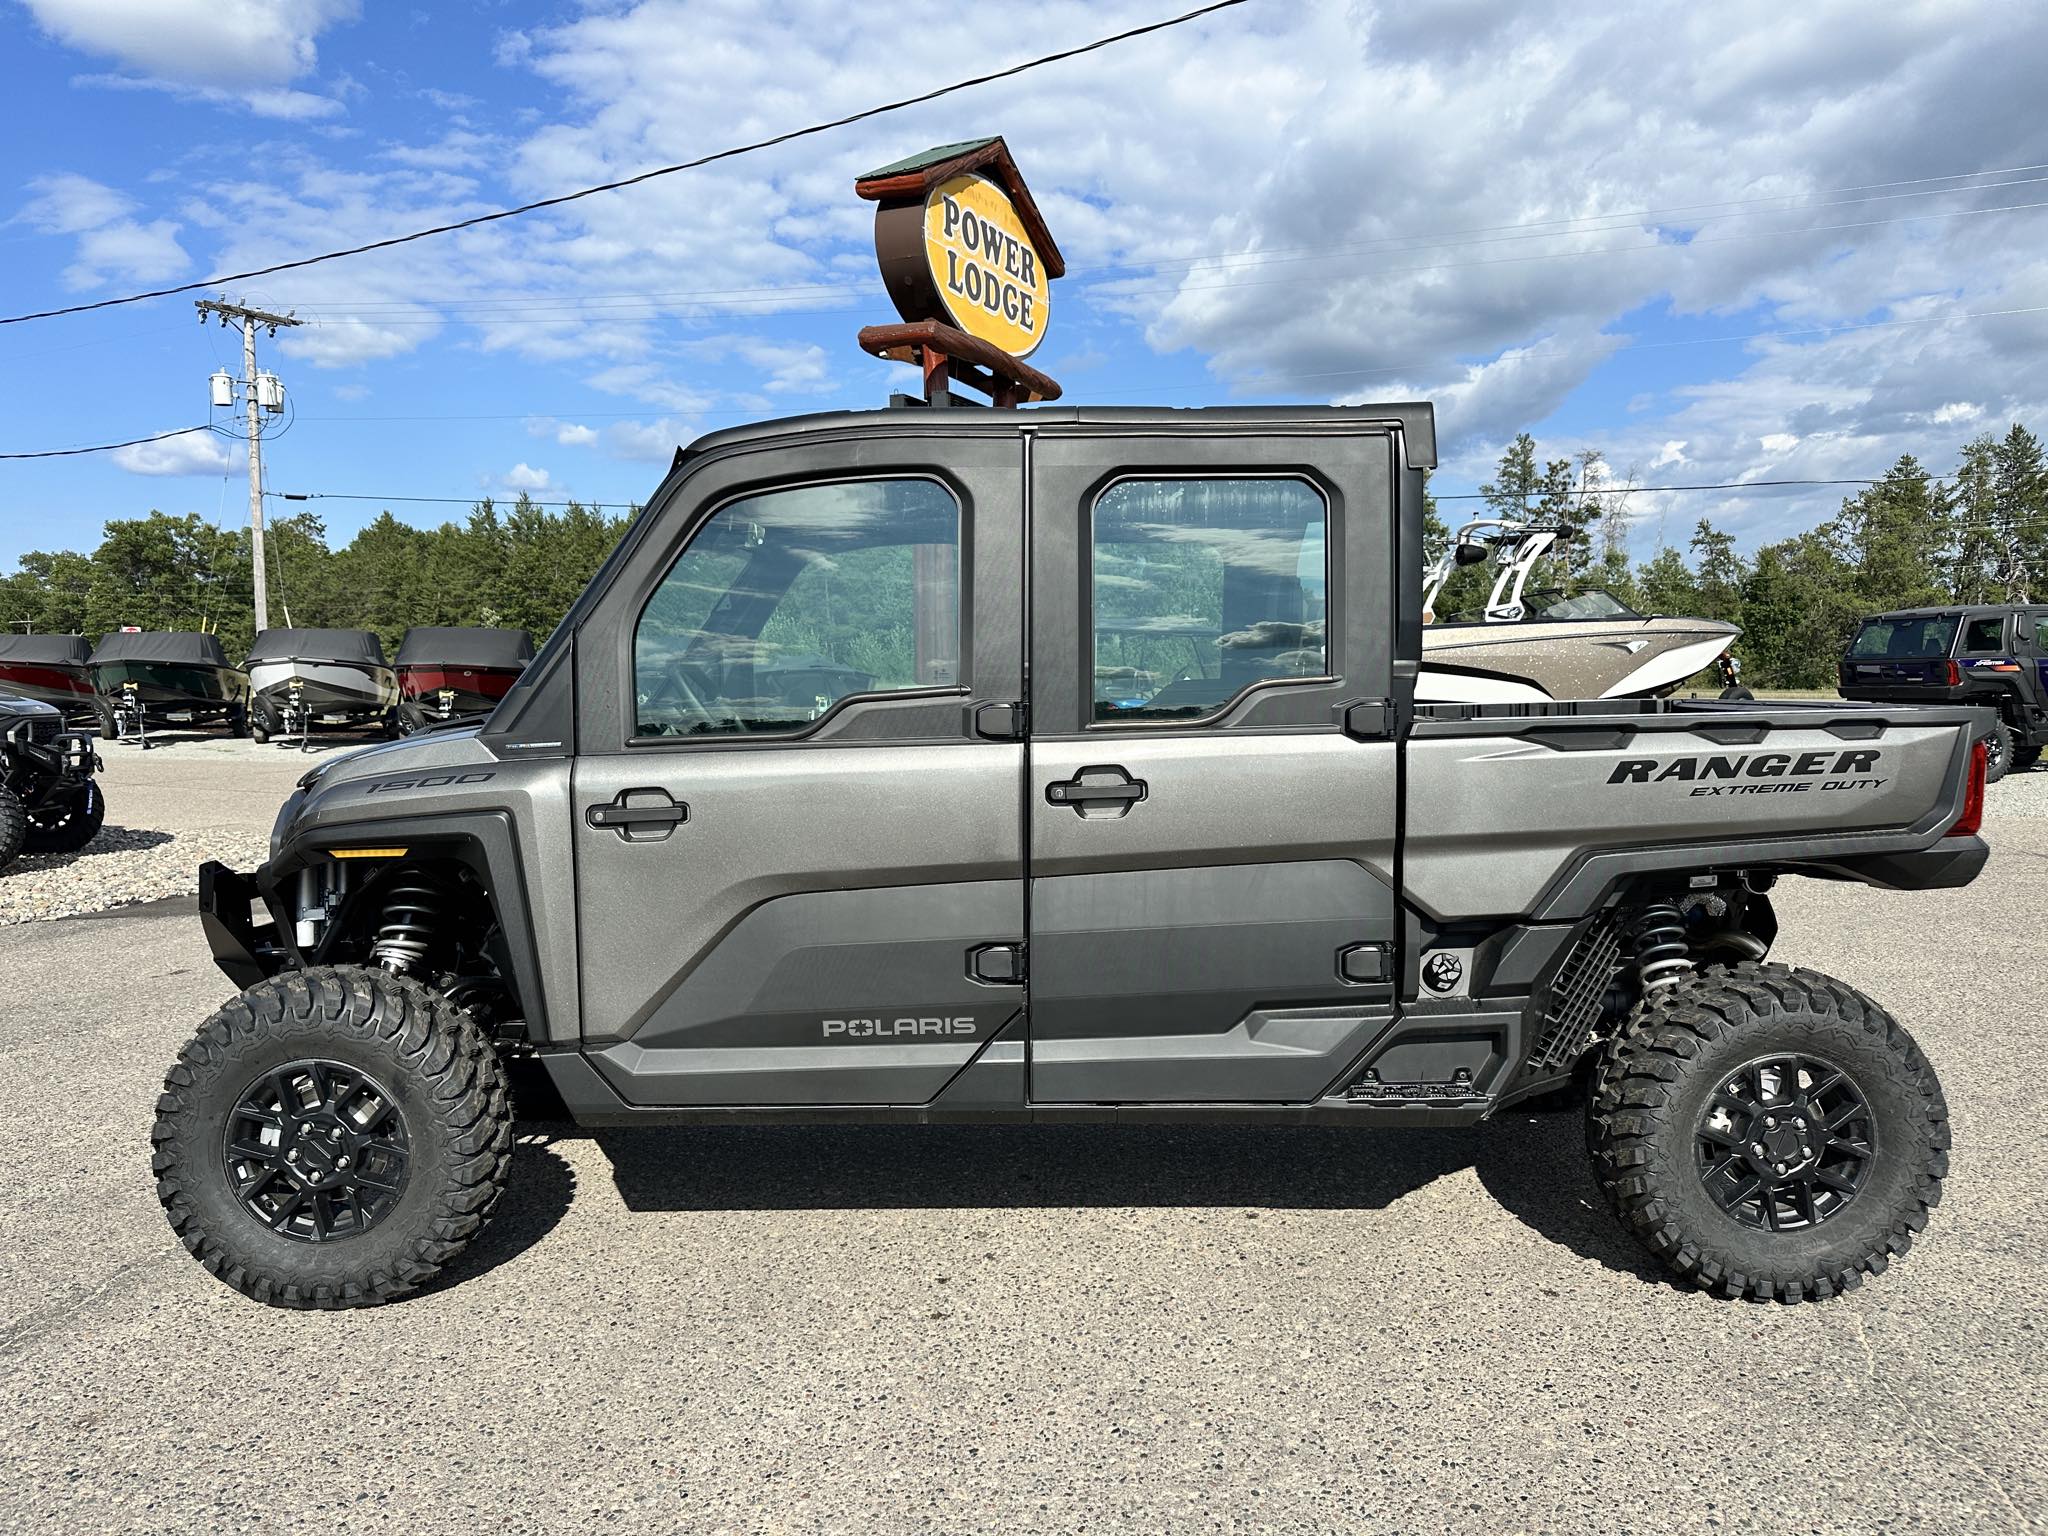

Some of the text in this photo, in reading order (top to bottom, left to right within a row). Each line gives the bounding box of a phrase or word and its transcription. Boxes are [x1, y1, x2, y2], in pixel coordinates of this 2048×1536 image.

[943, 196, 1036, 289] POWER
[948, 250, 1034, 331] LODGE
[1606, 750, 1881, 784] RANGER
[367, 772, 497, 794] 1500
[1689, 778, 1889, 797] EXTREME DUTY
[822, 1017, 977, 1037] POLARIS
